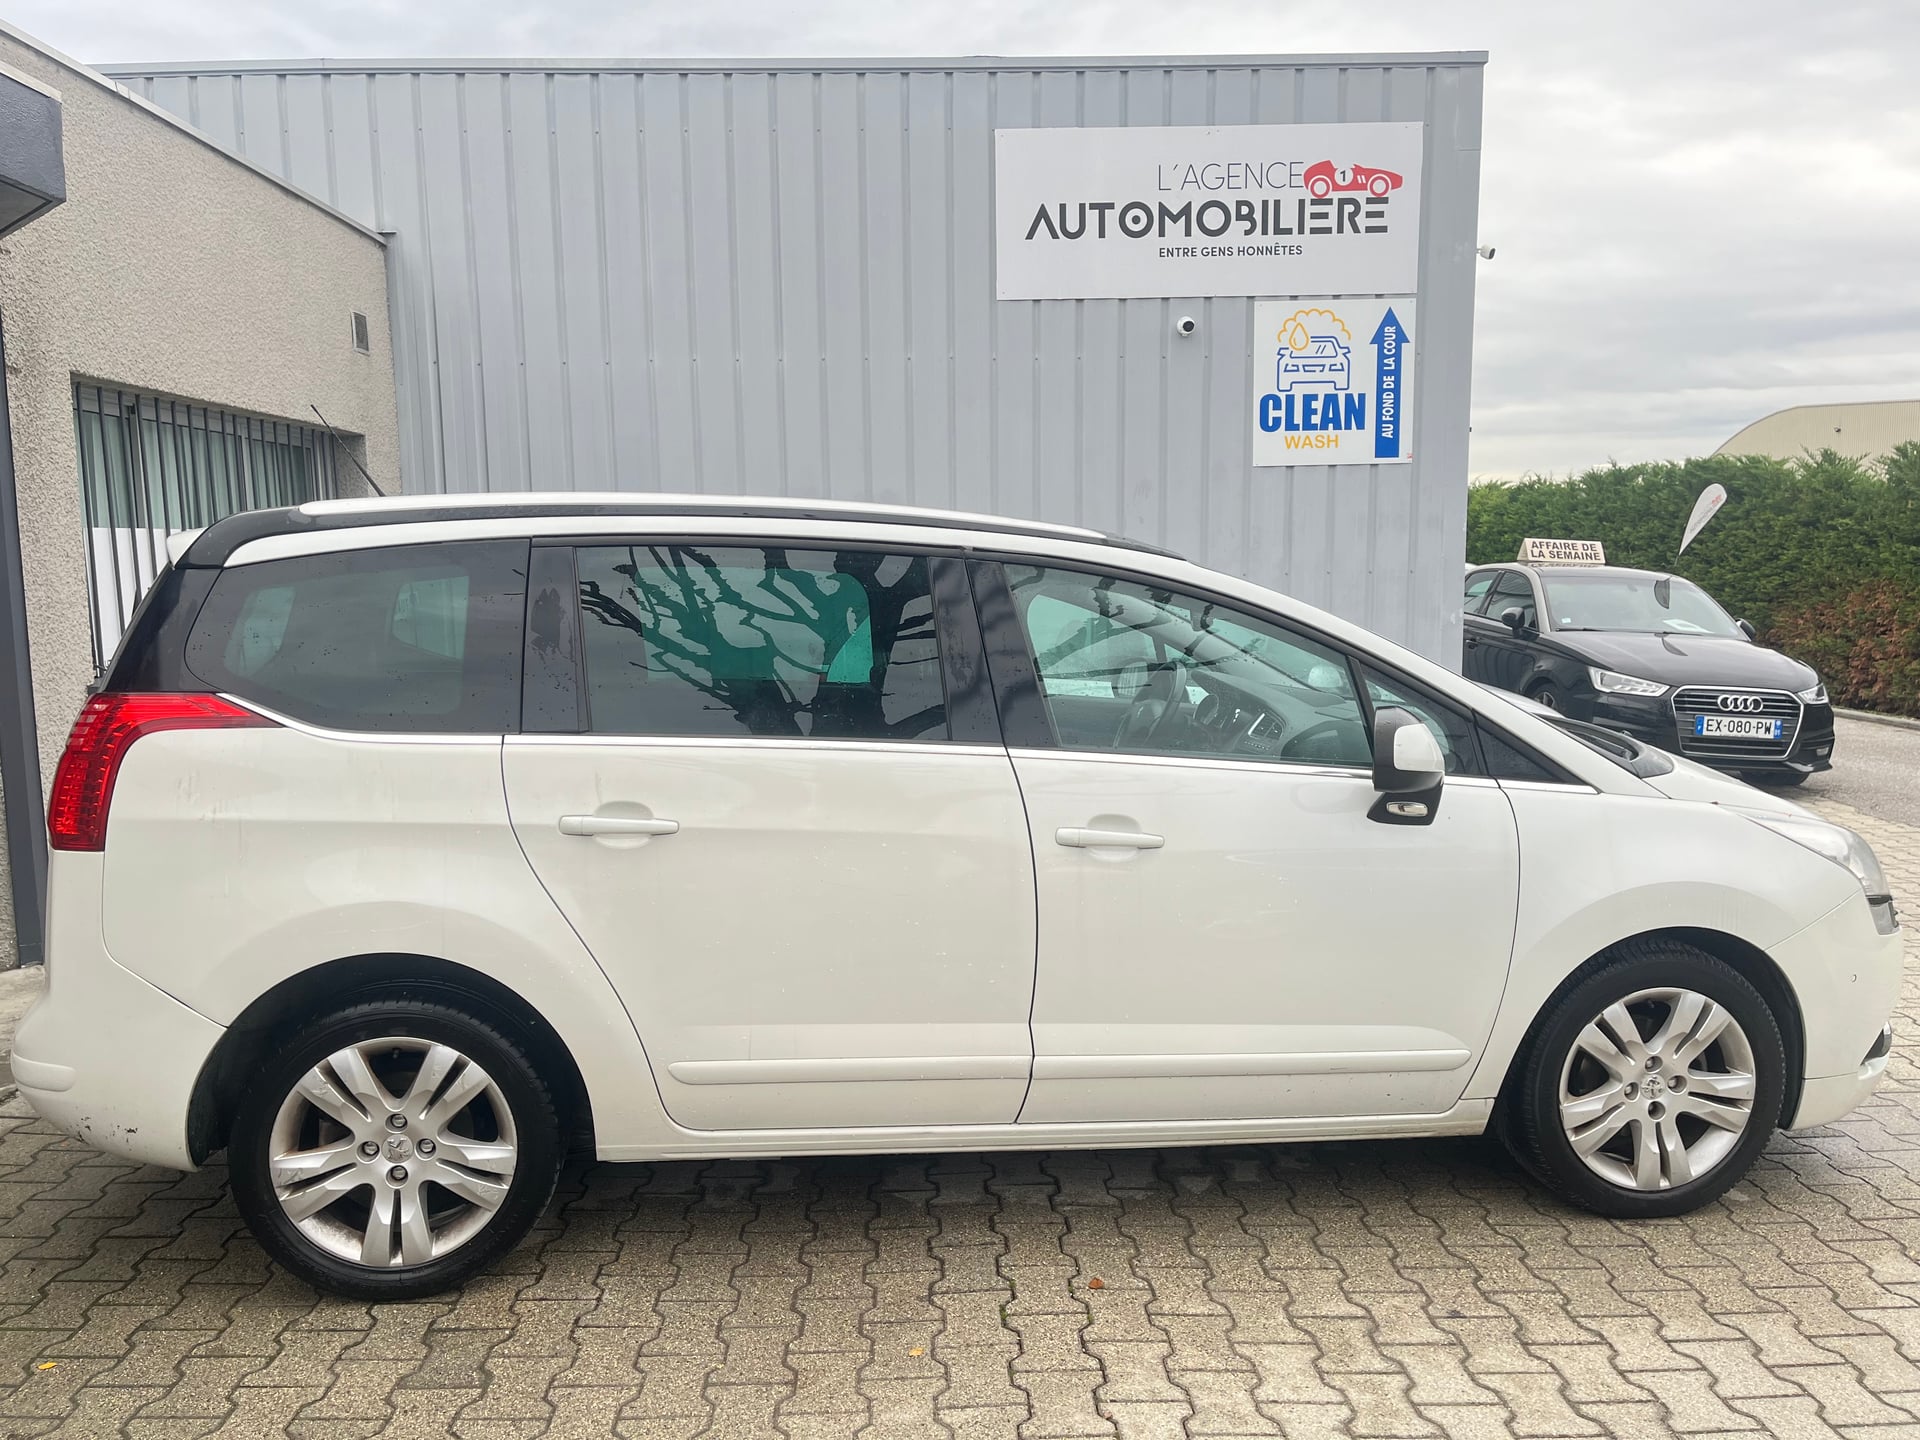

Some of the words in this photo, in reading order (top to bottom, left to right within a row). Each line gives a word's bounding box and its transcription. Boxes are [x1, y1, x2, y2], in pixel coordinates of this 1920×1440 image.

[1158, 161, 1304, 191] L'AGENCE
[1025, 197, 1389, 240] AUTOMOBILIERE
[1159, 246, 1197, 258] ENTRE
[1201, 246, 1234, 257] GENS
[1237, 242, 1303, 257] HONNÊTES
[1384, 326, 1396, 355] COUR
[1383, 357, 1396, 370] LA
[1383, 375, 1395, 389] DE
[1259, 393, 1366, 433] CLEAN
[1382, 391, 1394, 421] FOND
[1381, 423, 1394, 439] AU
[1284, 434, 1339, 449] WASH
[1531, 541, 1578, 551] AFFAIRE
[1582, 543, 1598, 552] DE
[1530, 550, 1546, 559] LA
[1549, 551, 1601, 560] SEMAINE
[1706, 719, 1772, 735] EX-080-PW
